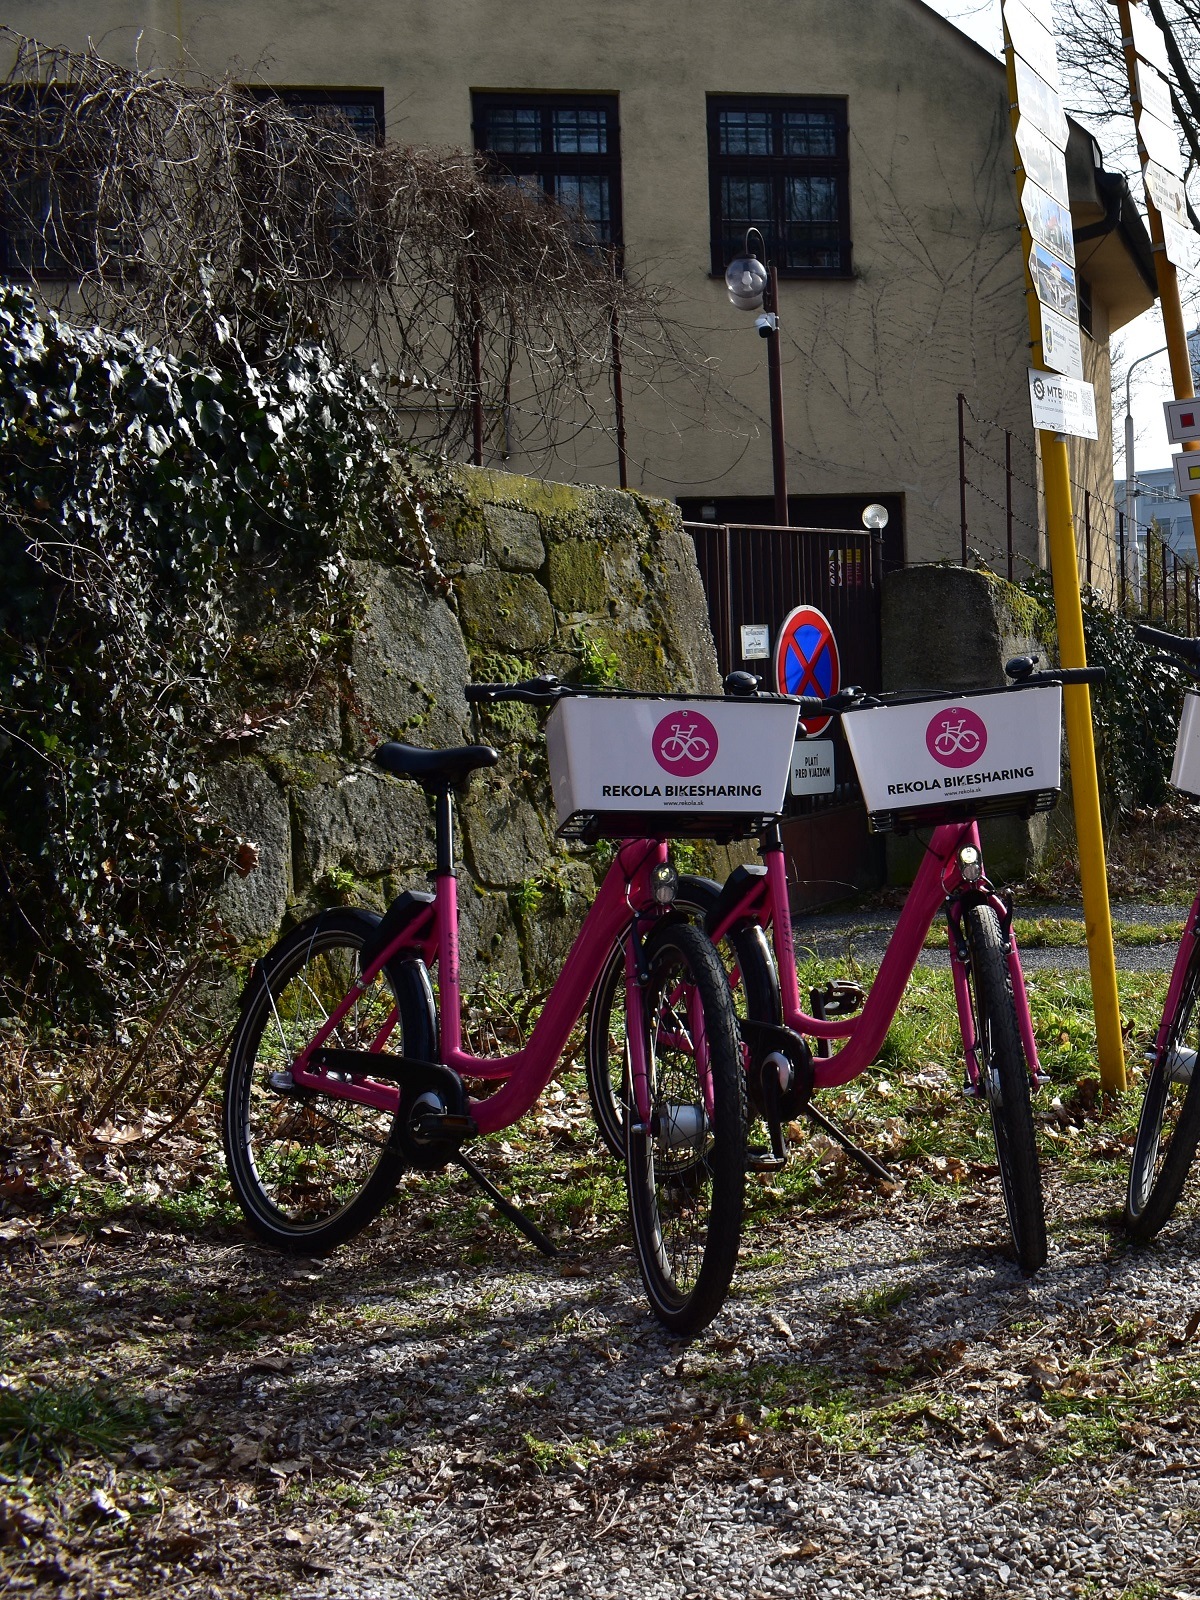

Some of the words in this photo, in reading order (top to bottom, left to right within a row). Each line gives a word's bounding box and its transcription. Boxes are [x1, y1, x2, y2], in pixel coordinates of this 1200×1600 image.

[1047, 386, 1078, 403] MTBIKER
[804, 754, 819, 766] PLATÍ
[795, 768, 808, 779] PRED
[809, 767, 831, 778] VJAZDOM
[888, 778, 941, 796] REKOLA
[944, 766, 1034, 789] BIKESHARING
[602, 785, 661, 797] REKOLA
[665, 785, 762, 797] BIKESHARING
[944, 787, 982, 797] www.rekola.sk
